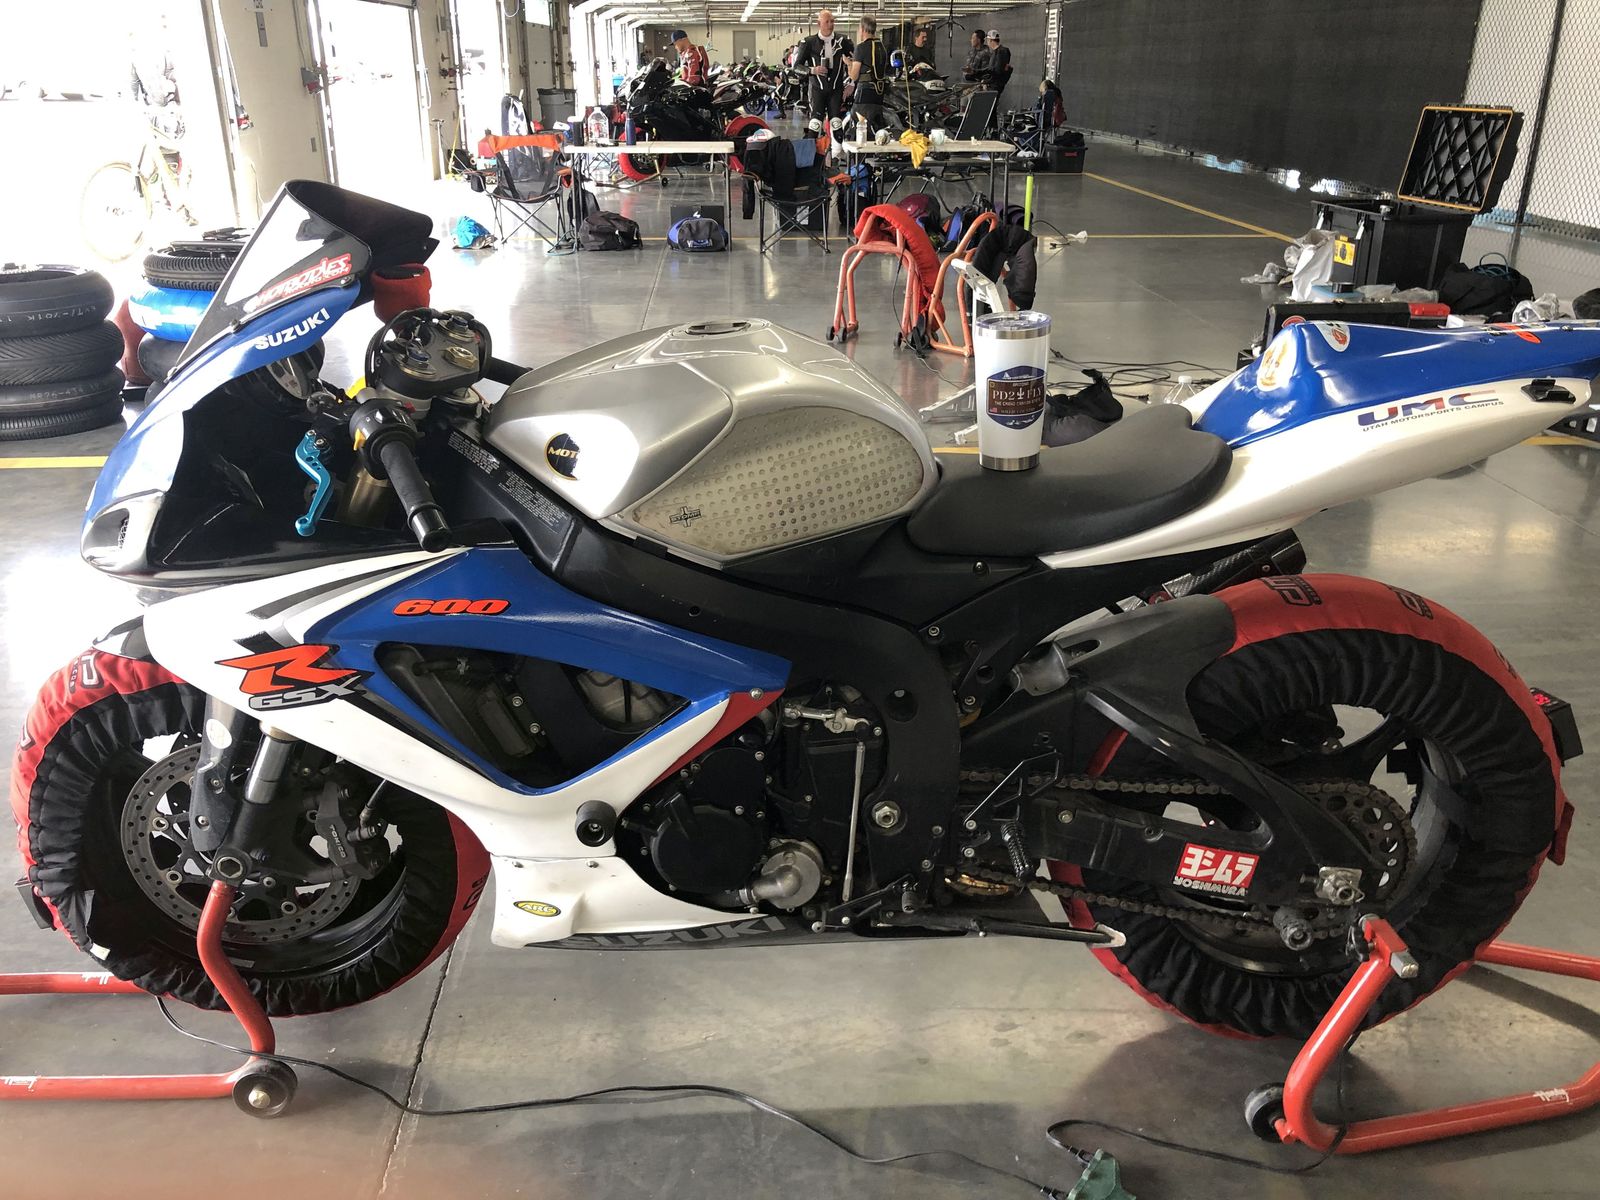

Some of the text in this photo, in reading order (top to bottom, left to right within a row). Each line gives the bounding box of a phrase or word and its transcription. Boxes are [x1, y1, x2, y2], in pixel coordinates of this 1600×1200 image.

[254, 307, 331, 350] SUZUKI
[1357, 389, 1499, 427] UMC
[1362, 400, 1505, 432] UTAH MOTORSPORTS CAMPUS
[547, 446, 578, 459] MOT
[392, 598, 510, 617] 600
[215, 643, 358, 694] R
[249, 675, 362, 710] GSX
[329, 824, 347, 859] TOKICO
[1180, 846, 1256, 886] ヨシムラ
[1172, 875, 1246, 898] YOSHIMURA
[561, 916, 787, 948] SUZUKI
